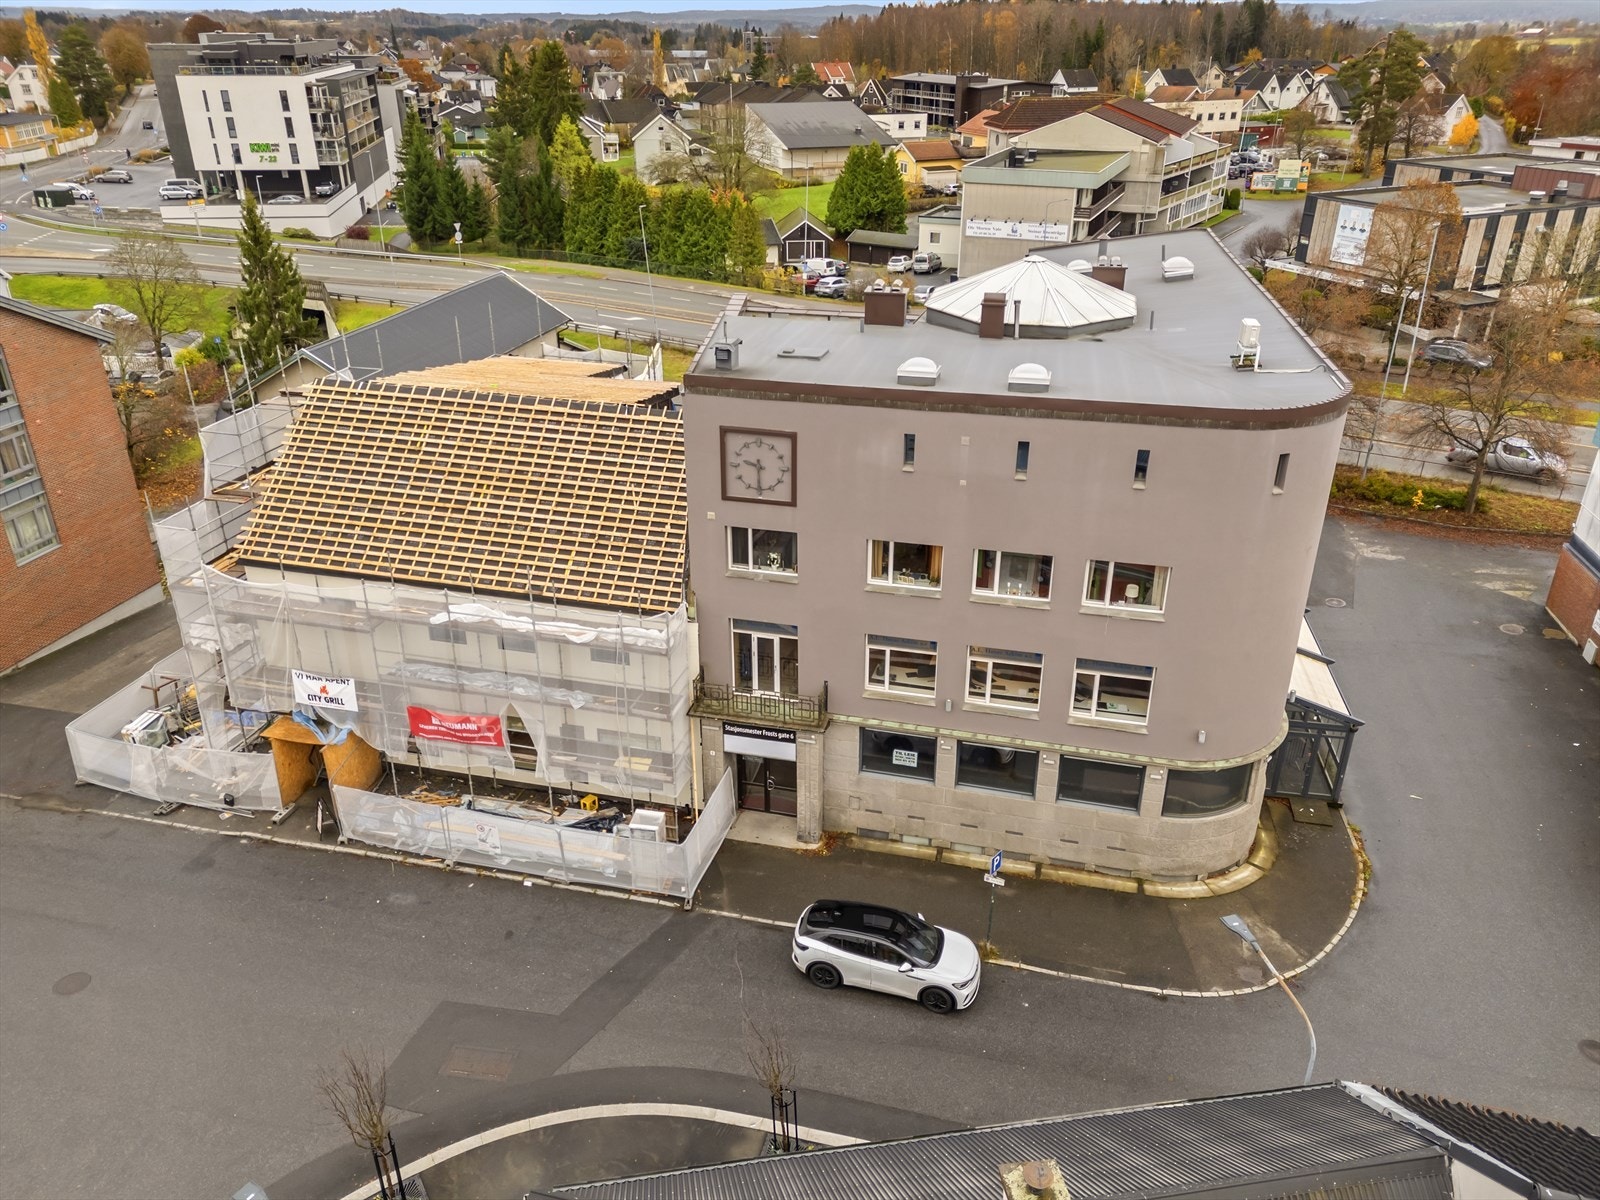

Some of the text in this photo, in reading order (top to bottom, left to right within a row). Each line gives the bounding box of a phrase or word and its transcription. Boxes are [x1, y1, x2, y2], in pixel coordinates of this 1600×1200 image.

[249, 143, 271, 153] KIWI
[307, 694, 345, 705] CITY GRILL
[724, 724, 762, 735] Stasjonsmester
[763, 729, 778, 737] Frosts
[994, 855, 1000, 871] P
